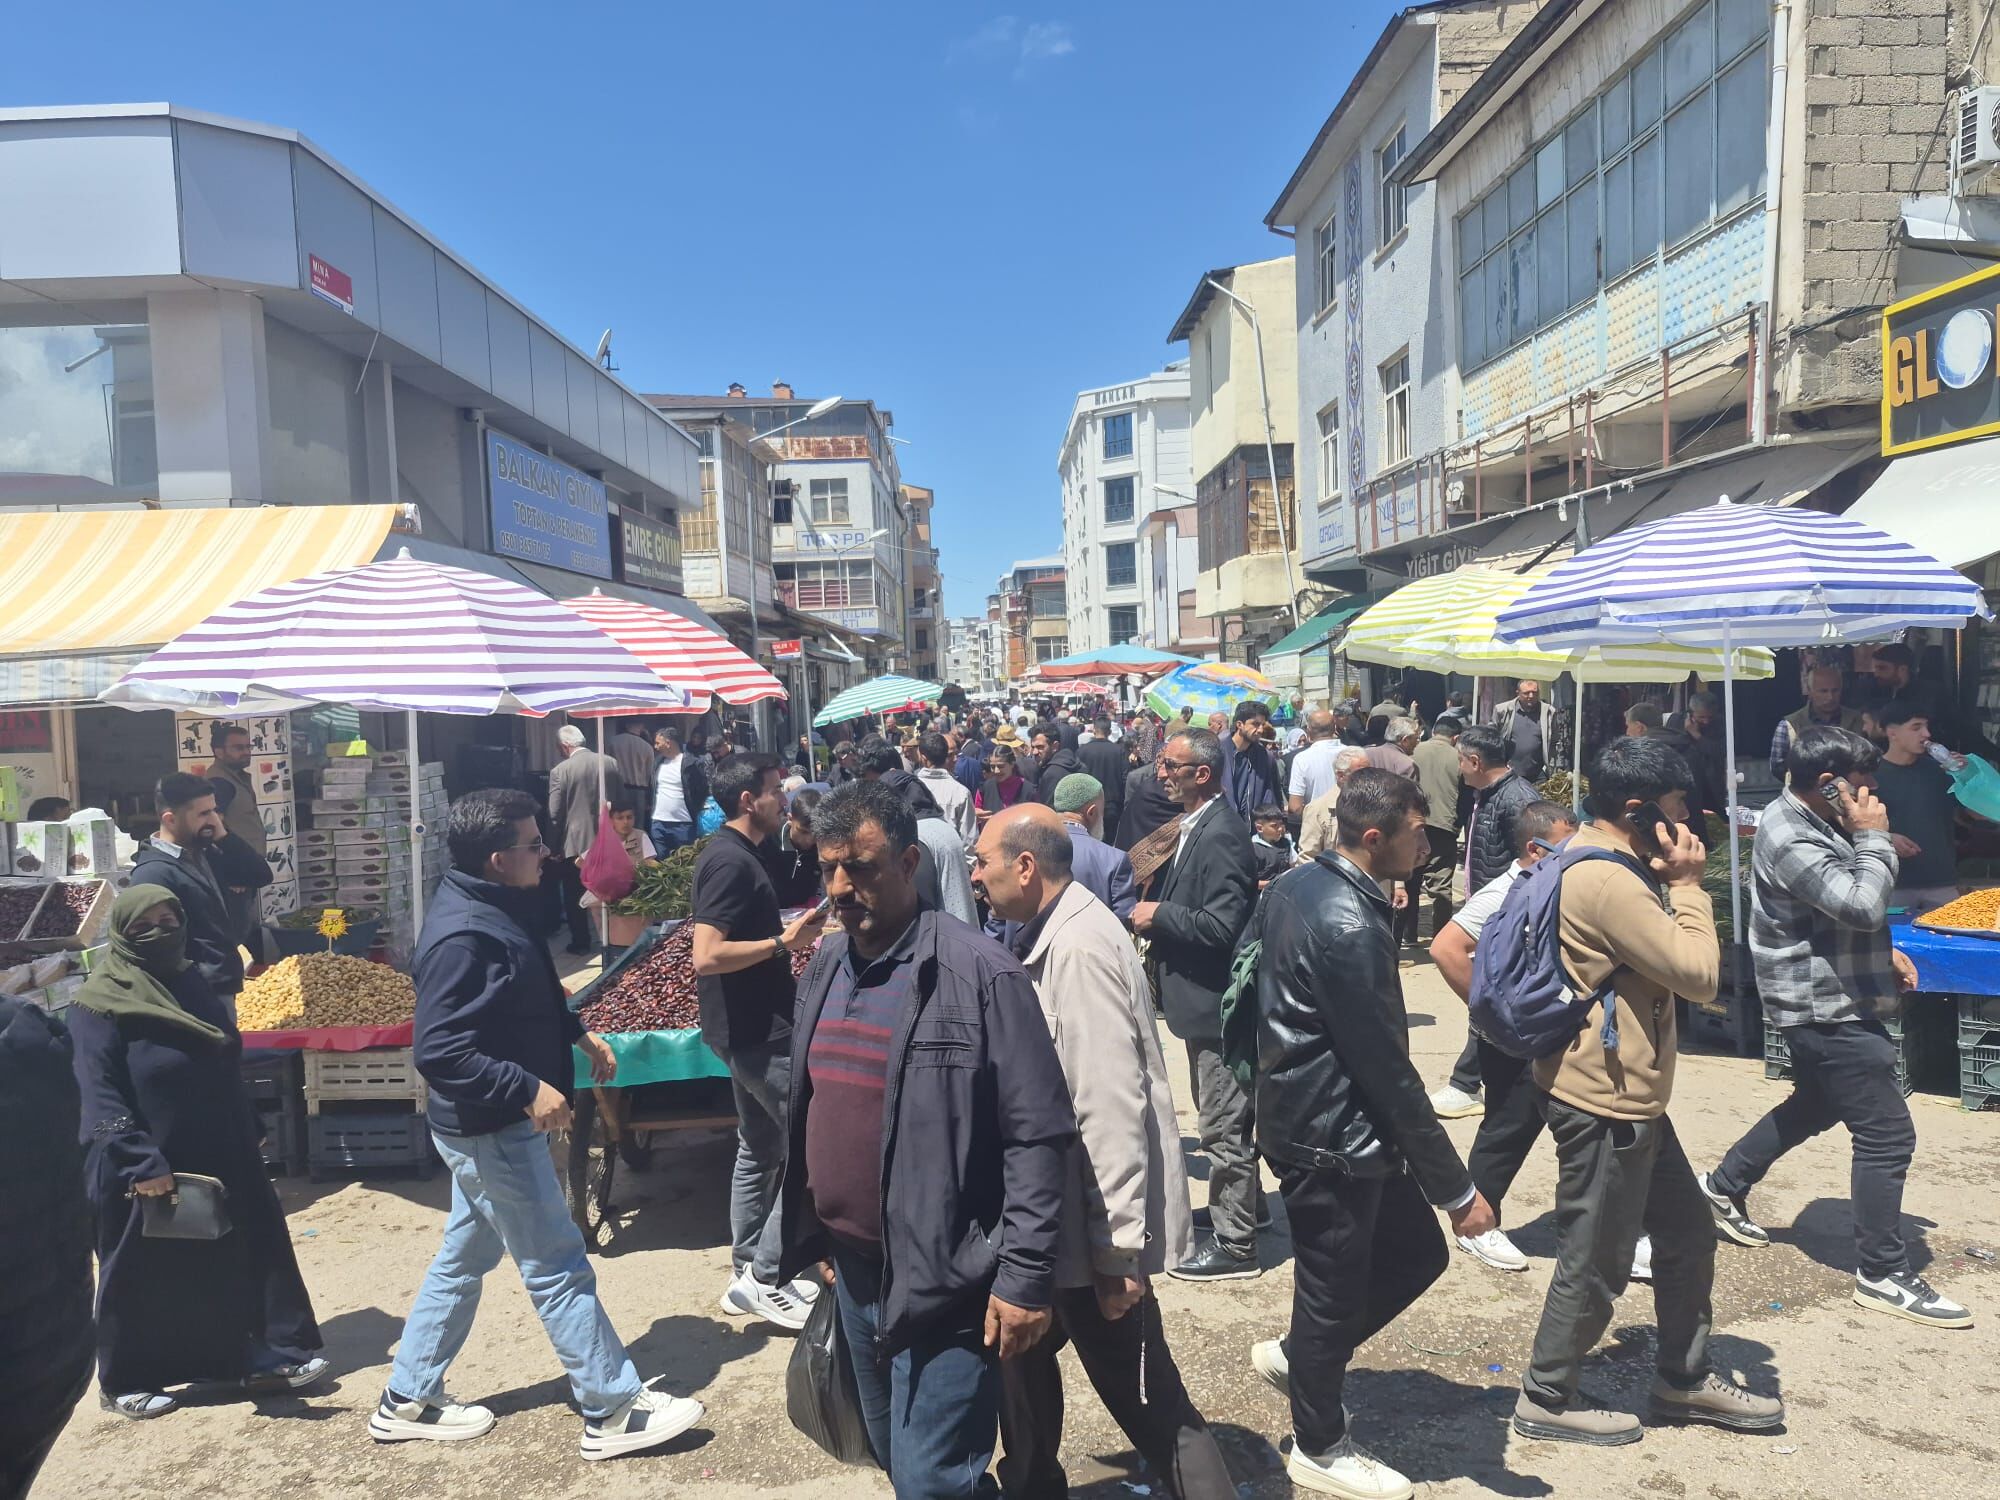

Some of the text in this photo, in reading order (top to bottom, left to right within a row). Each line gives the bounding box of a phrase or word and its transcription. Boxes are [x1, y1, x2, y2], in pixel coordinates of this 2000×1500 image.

[495, 442, 607, 520] BALKAN GİYİM
[513, 499, 551, 532] TOPTAN
[558, 516, 597, 549] PERAKENDE
[623, 521, 653, 561] EMRE
[655, 527, 681, 567] GİYİM
[1406, 553, 1440, 579] YİĞİT
